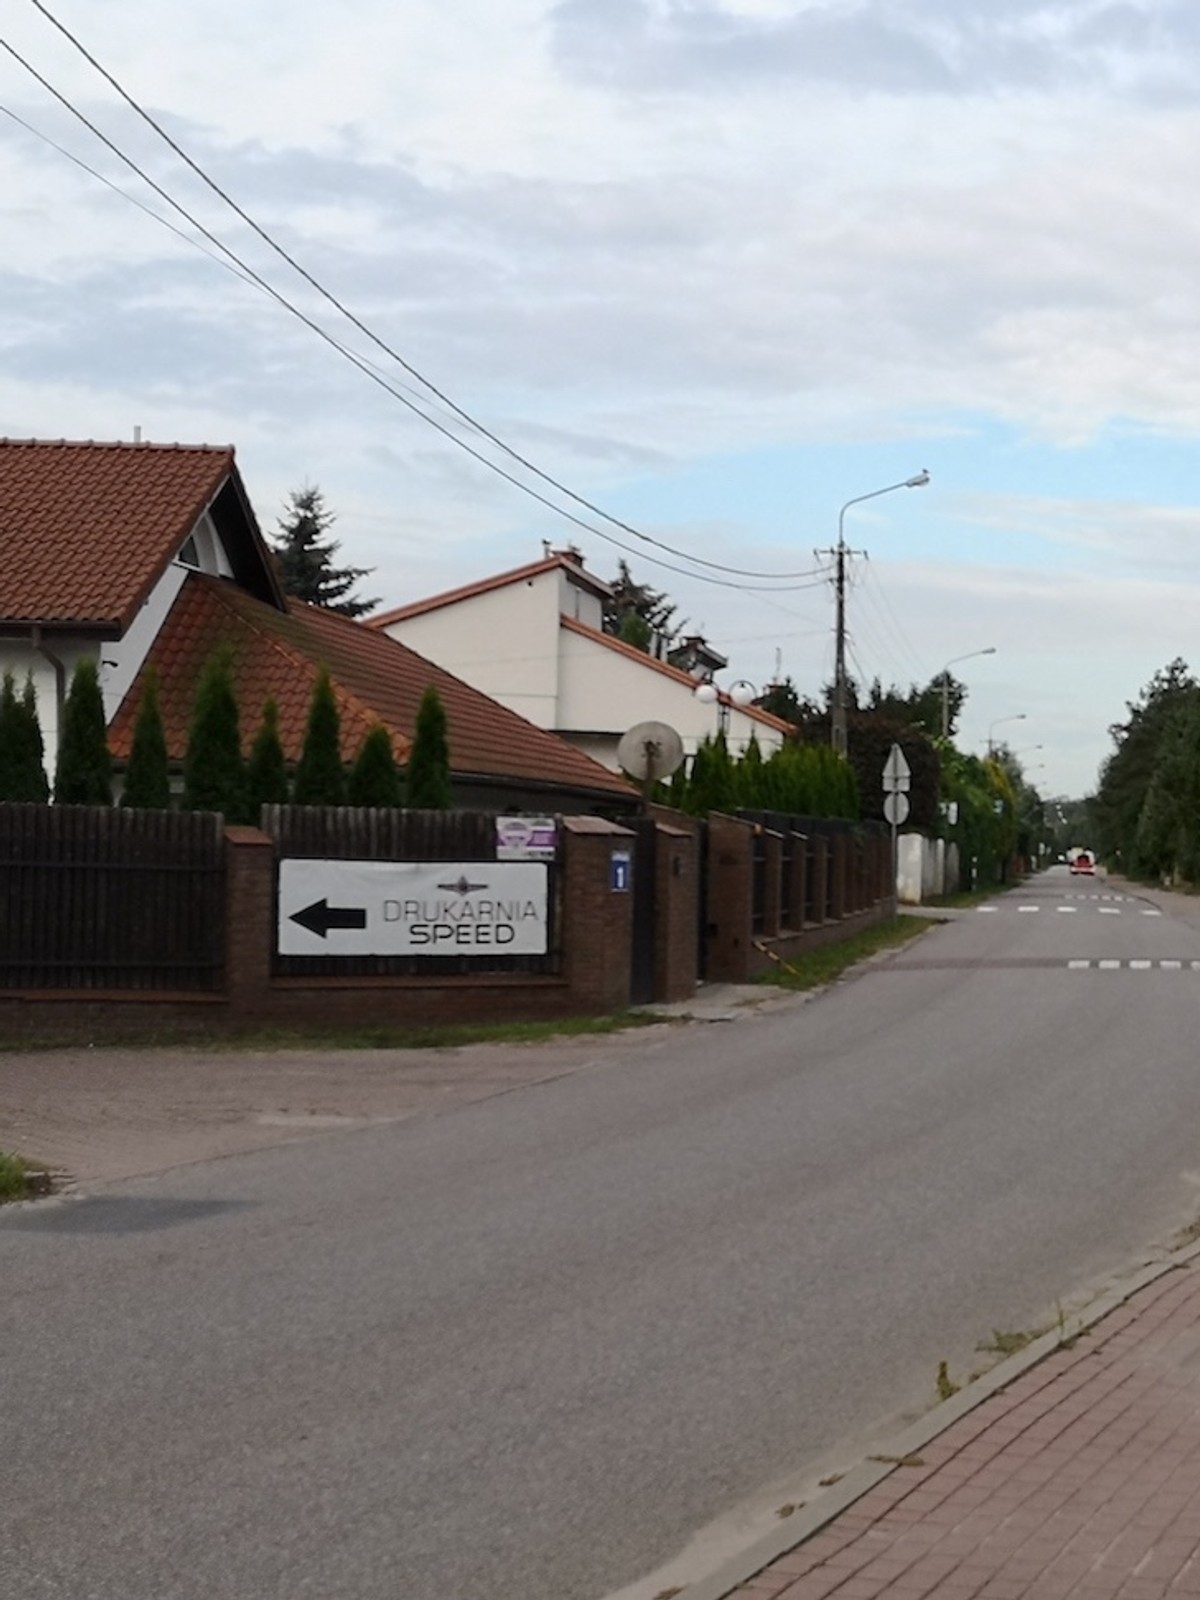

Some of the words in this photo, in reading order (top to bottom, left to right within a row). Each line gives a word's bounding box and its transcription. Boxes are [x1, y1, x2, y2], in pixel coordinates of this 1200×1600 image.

[615, 866, 625, 889] 1
[384, 899, 539, 922] DRUKARNIA
[409, 923, 515, 945] SPEED
